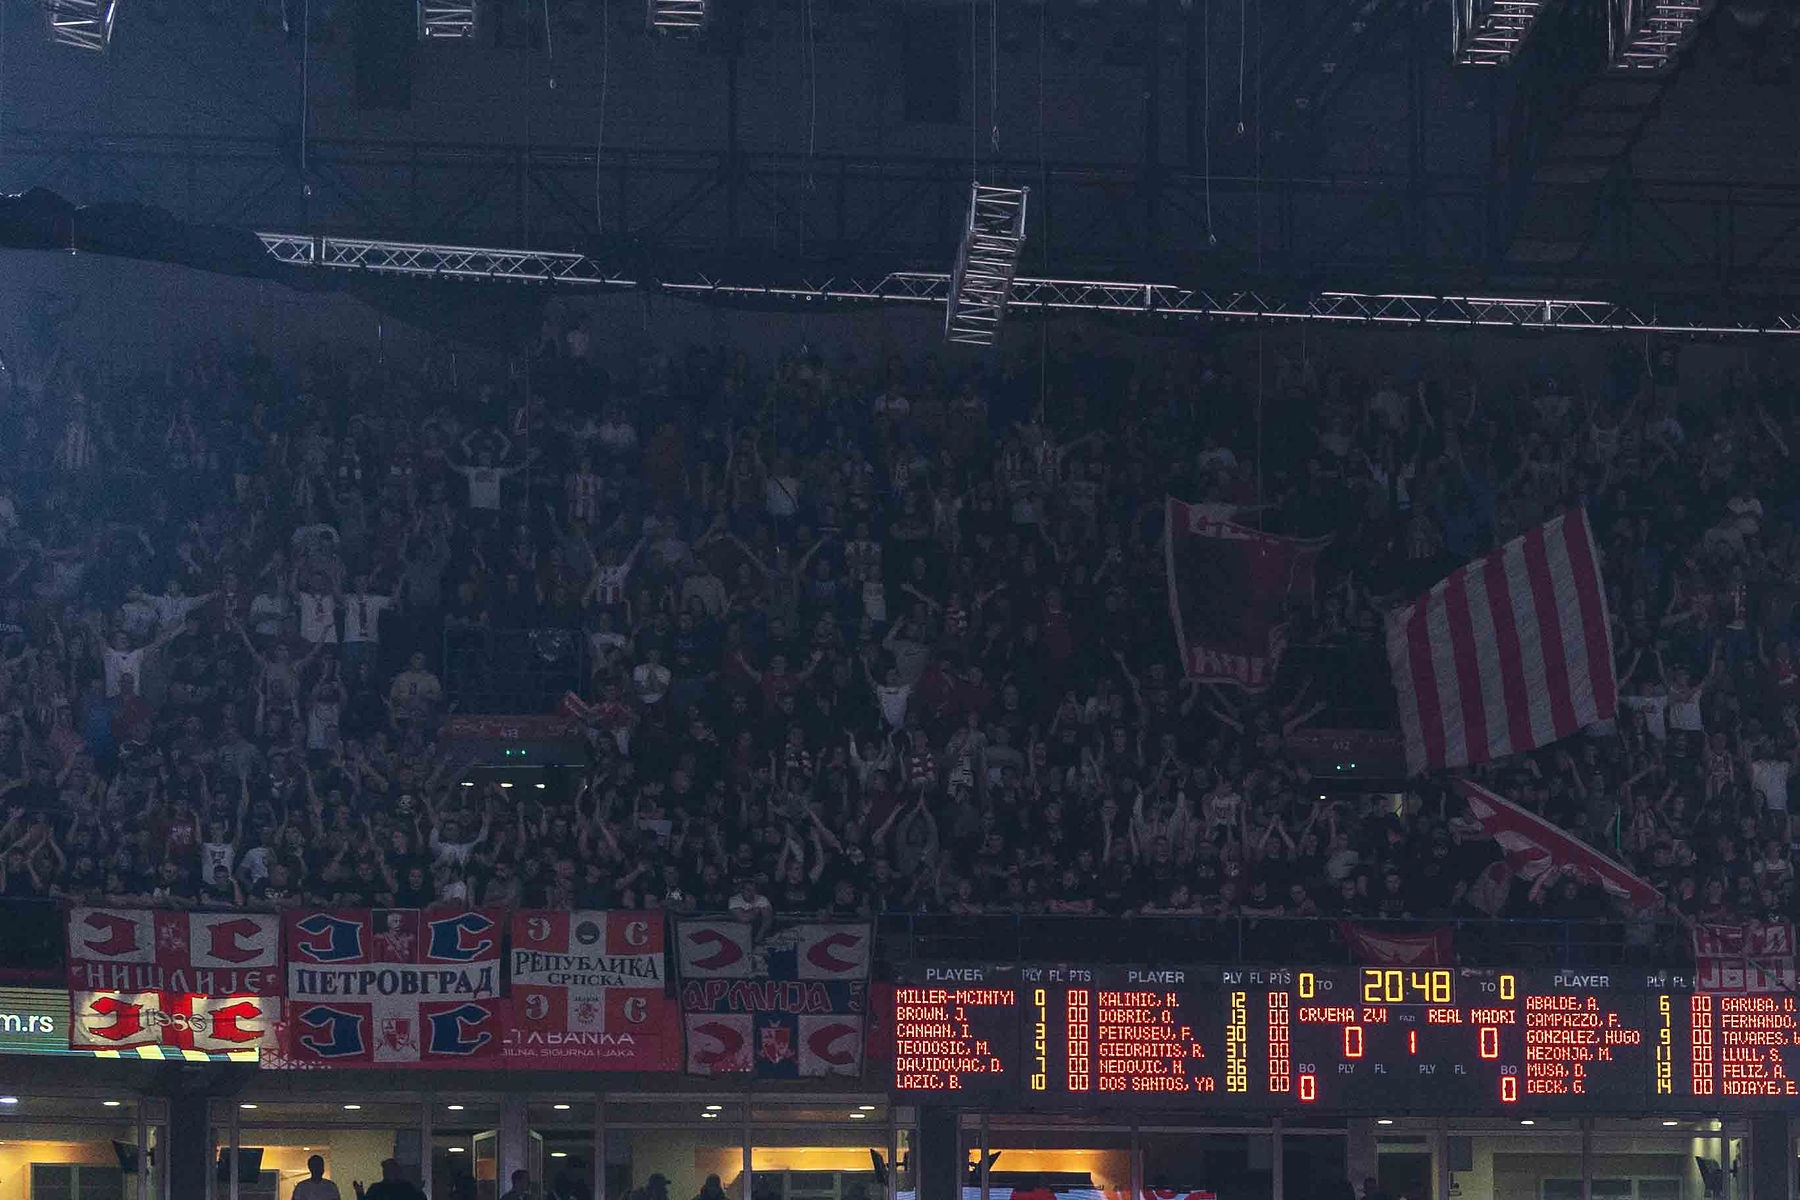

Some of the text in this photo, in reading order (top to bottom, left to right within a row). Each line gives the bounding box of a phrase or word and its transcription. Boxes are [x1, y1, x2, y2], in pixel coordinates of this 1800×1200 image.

[514, 951, 661, 981] РЕПУБЛИКА
[296, 968, 494, 998] ПЕТРОВГРАД
[547, 972, 627, 987] СРПСКА
[926, 968, 984, 982] PLAYER
[1069, 970, 1092, 983] PTS
[1128, 970, 1185, 984] PLAYER
[1269, 972, 1292, 984] PTS
[1553, 975, 1611, 988] PLAYER
[1299, 972, 1314, 999] 0
[1316, 980, 1333, 991] TO
[1364, 969, 1451, 1003] 20:48
[1480, 982, 1497, 993] TO
[1499, 975, 1515, 1000] 0
[1034, 988, 1046, 1006] 0
[1098, 991, 1162, 1007] KALINIC,
[1231, 991, 1246, 1009] 12
[1526, 995, 1582, 1011] ABALDE,
[1659, 995, 1670, 1012] 6
[1721, 997, 1779, 1012] GARUBA,
[896, 1006, 949, 1021] BROWN,
[1041, 1006, 1046, 1023] 1
[1098, 1008, 1157, 1024] DOBRIC,
[1231, 1008, 1247, 1025] 13
[1299, 1007, 1355, 1023] CRVENA
[1428, 1008, 1463, 1024] REAL
[1471, 1008, 1516, 1024] MADRI
[1526, 1012, 1604, 1028] CAMPAZZO,
[1660, 1011, 1671, 1028] 7
[1721, 1014, 1797, 1029] FERNANDO,
[896, 1023, 957, 1038] CANAAN,
[1035, 1022, 1046, 1040] 3
[1098, 1025, 1177, 1041] PETRUSEV,
[1226, 1024, 1247, 1042] 30
[1526, 1028, 1671, 1045] GONZALEZ, HUGO 9
[1721, 1030, 1789, 1046] TAVARES,
[896, 1040, 971, 1056] TEODOSIC,
[1035, 1040, 1046, 1056] 4
[1099, 1042, 1187, 1058] GIEDRAITIS,
[1226, 1041, 1247, 1059] 31
[1344, 1025, 1363, 1058] 0
[1410, 1030, 1416, 1054] 1
[1480, 1027, 1499, 1059] 0
[1526, 1045, 1594, 1061] HEZONJA,
[1656, 1045, 1671, 1061] 11
[1722, 1047, 1765, 1062] LLULL,
[896, 1057, 986, 1073] DAVIDOVAC,
[1035, 1056, 1046, 1074] 7
[1099, 1059, 1168, 1074] NEDOVIC,
[1226, 1058, 1247, 1076] 36
[1299, 1063, 1316, 1074] BO
[1500, 1065, 1518, 1075] BO
[1526, 1062, 1570, 1078] MUSA,
[1657, 1061, 1672, 1079] 13
[1722, 1063, 1769, 1079] FELIZ,
[896, 1073, 944, 1089] LAZIC,
[1031, 1073, 1046, 1091] 10
[1099, 1075, 1247, 1093] DOS SANTOS, YA 99
[1300, 1074, 1315, 1101] 0
[1501, 1076, 1517, 1102] 0
[1527, 1079, 1568, 1094] DECK,
[1657, 1078, 1672, 1095] 14
[1723, 1080, 1782, 1095] NDIAYE,
